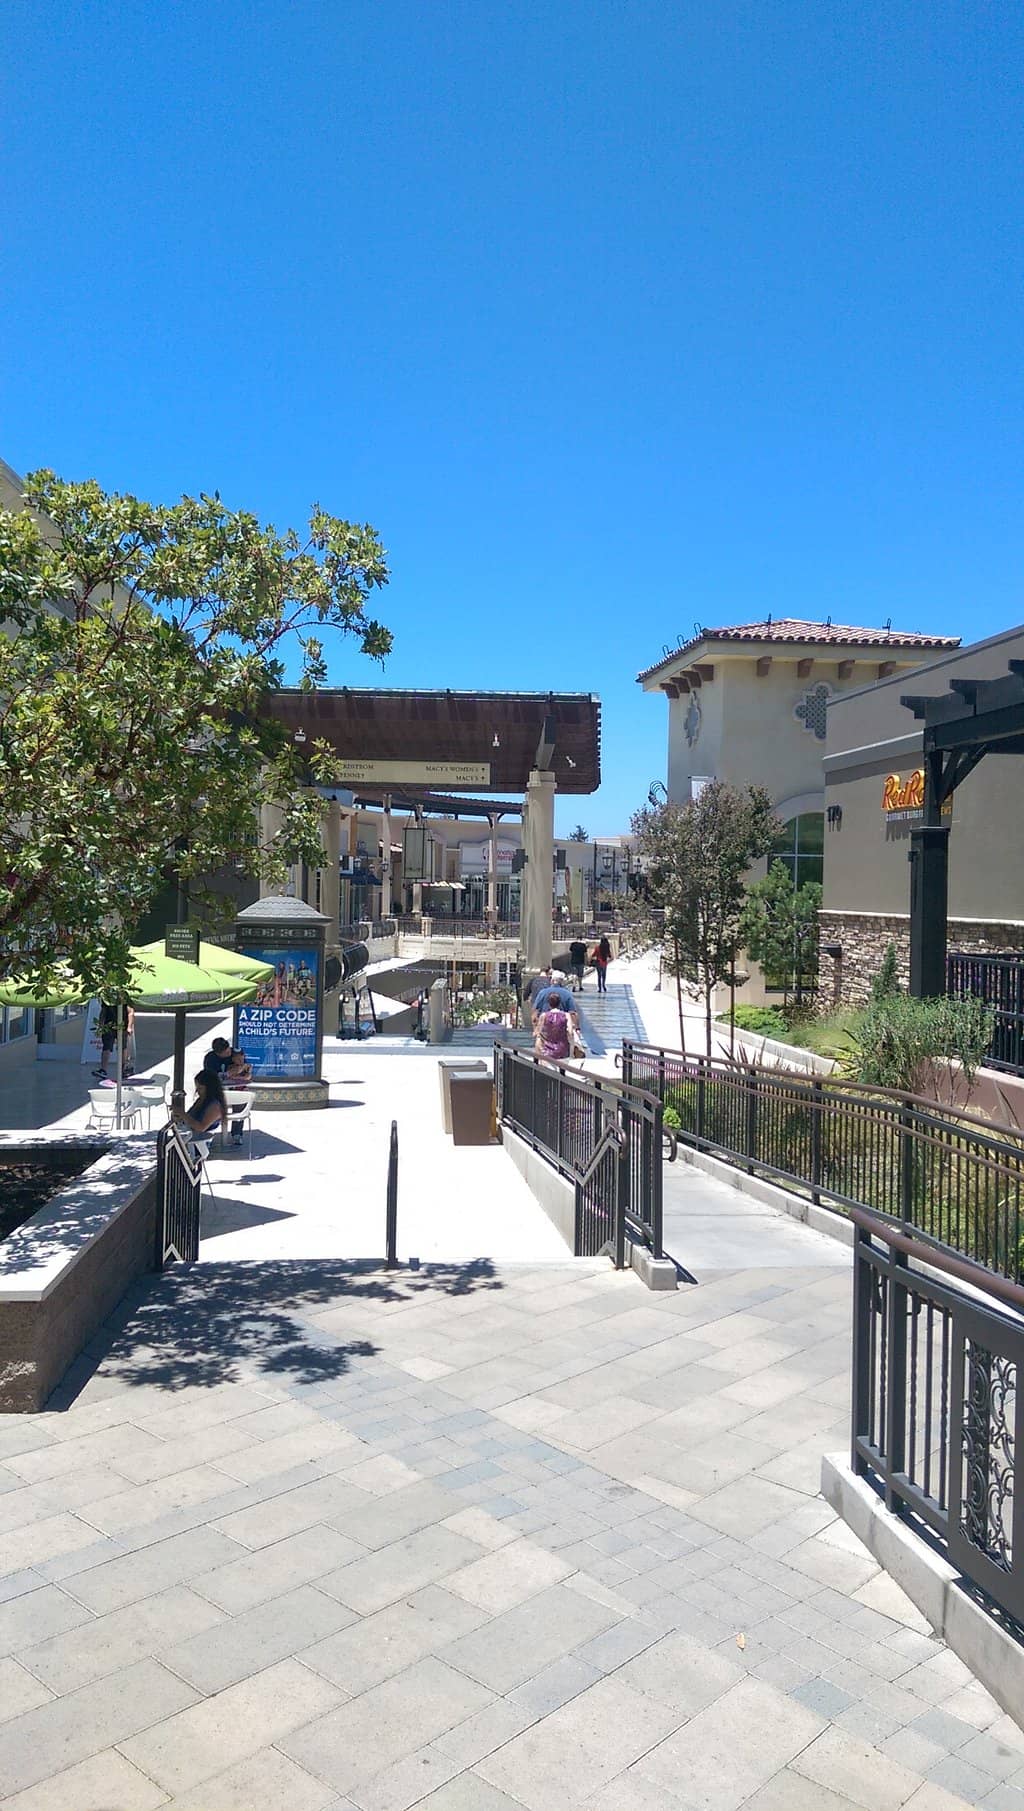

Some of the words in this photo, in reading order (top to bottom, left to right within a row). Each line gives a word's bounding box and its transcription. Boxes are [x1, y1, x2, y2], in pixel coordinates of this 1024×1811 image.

[239, 1009, 248, 1020] A
[250, 1009, 273, 1021] ZIP
[276, 1010, 316, 1021] CODE
[245, 1028, 277, 1036] CHILD'S
